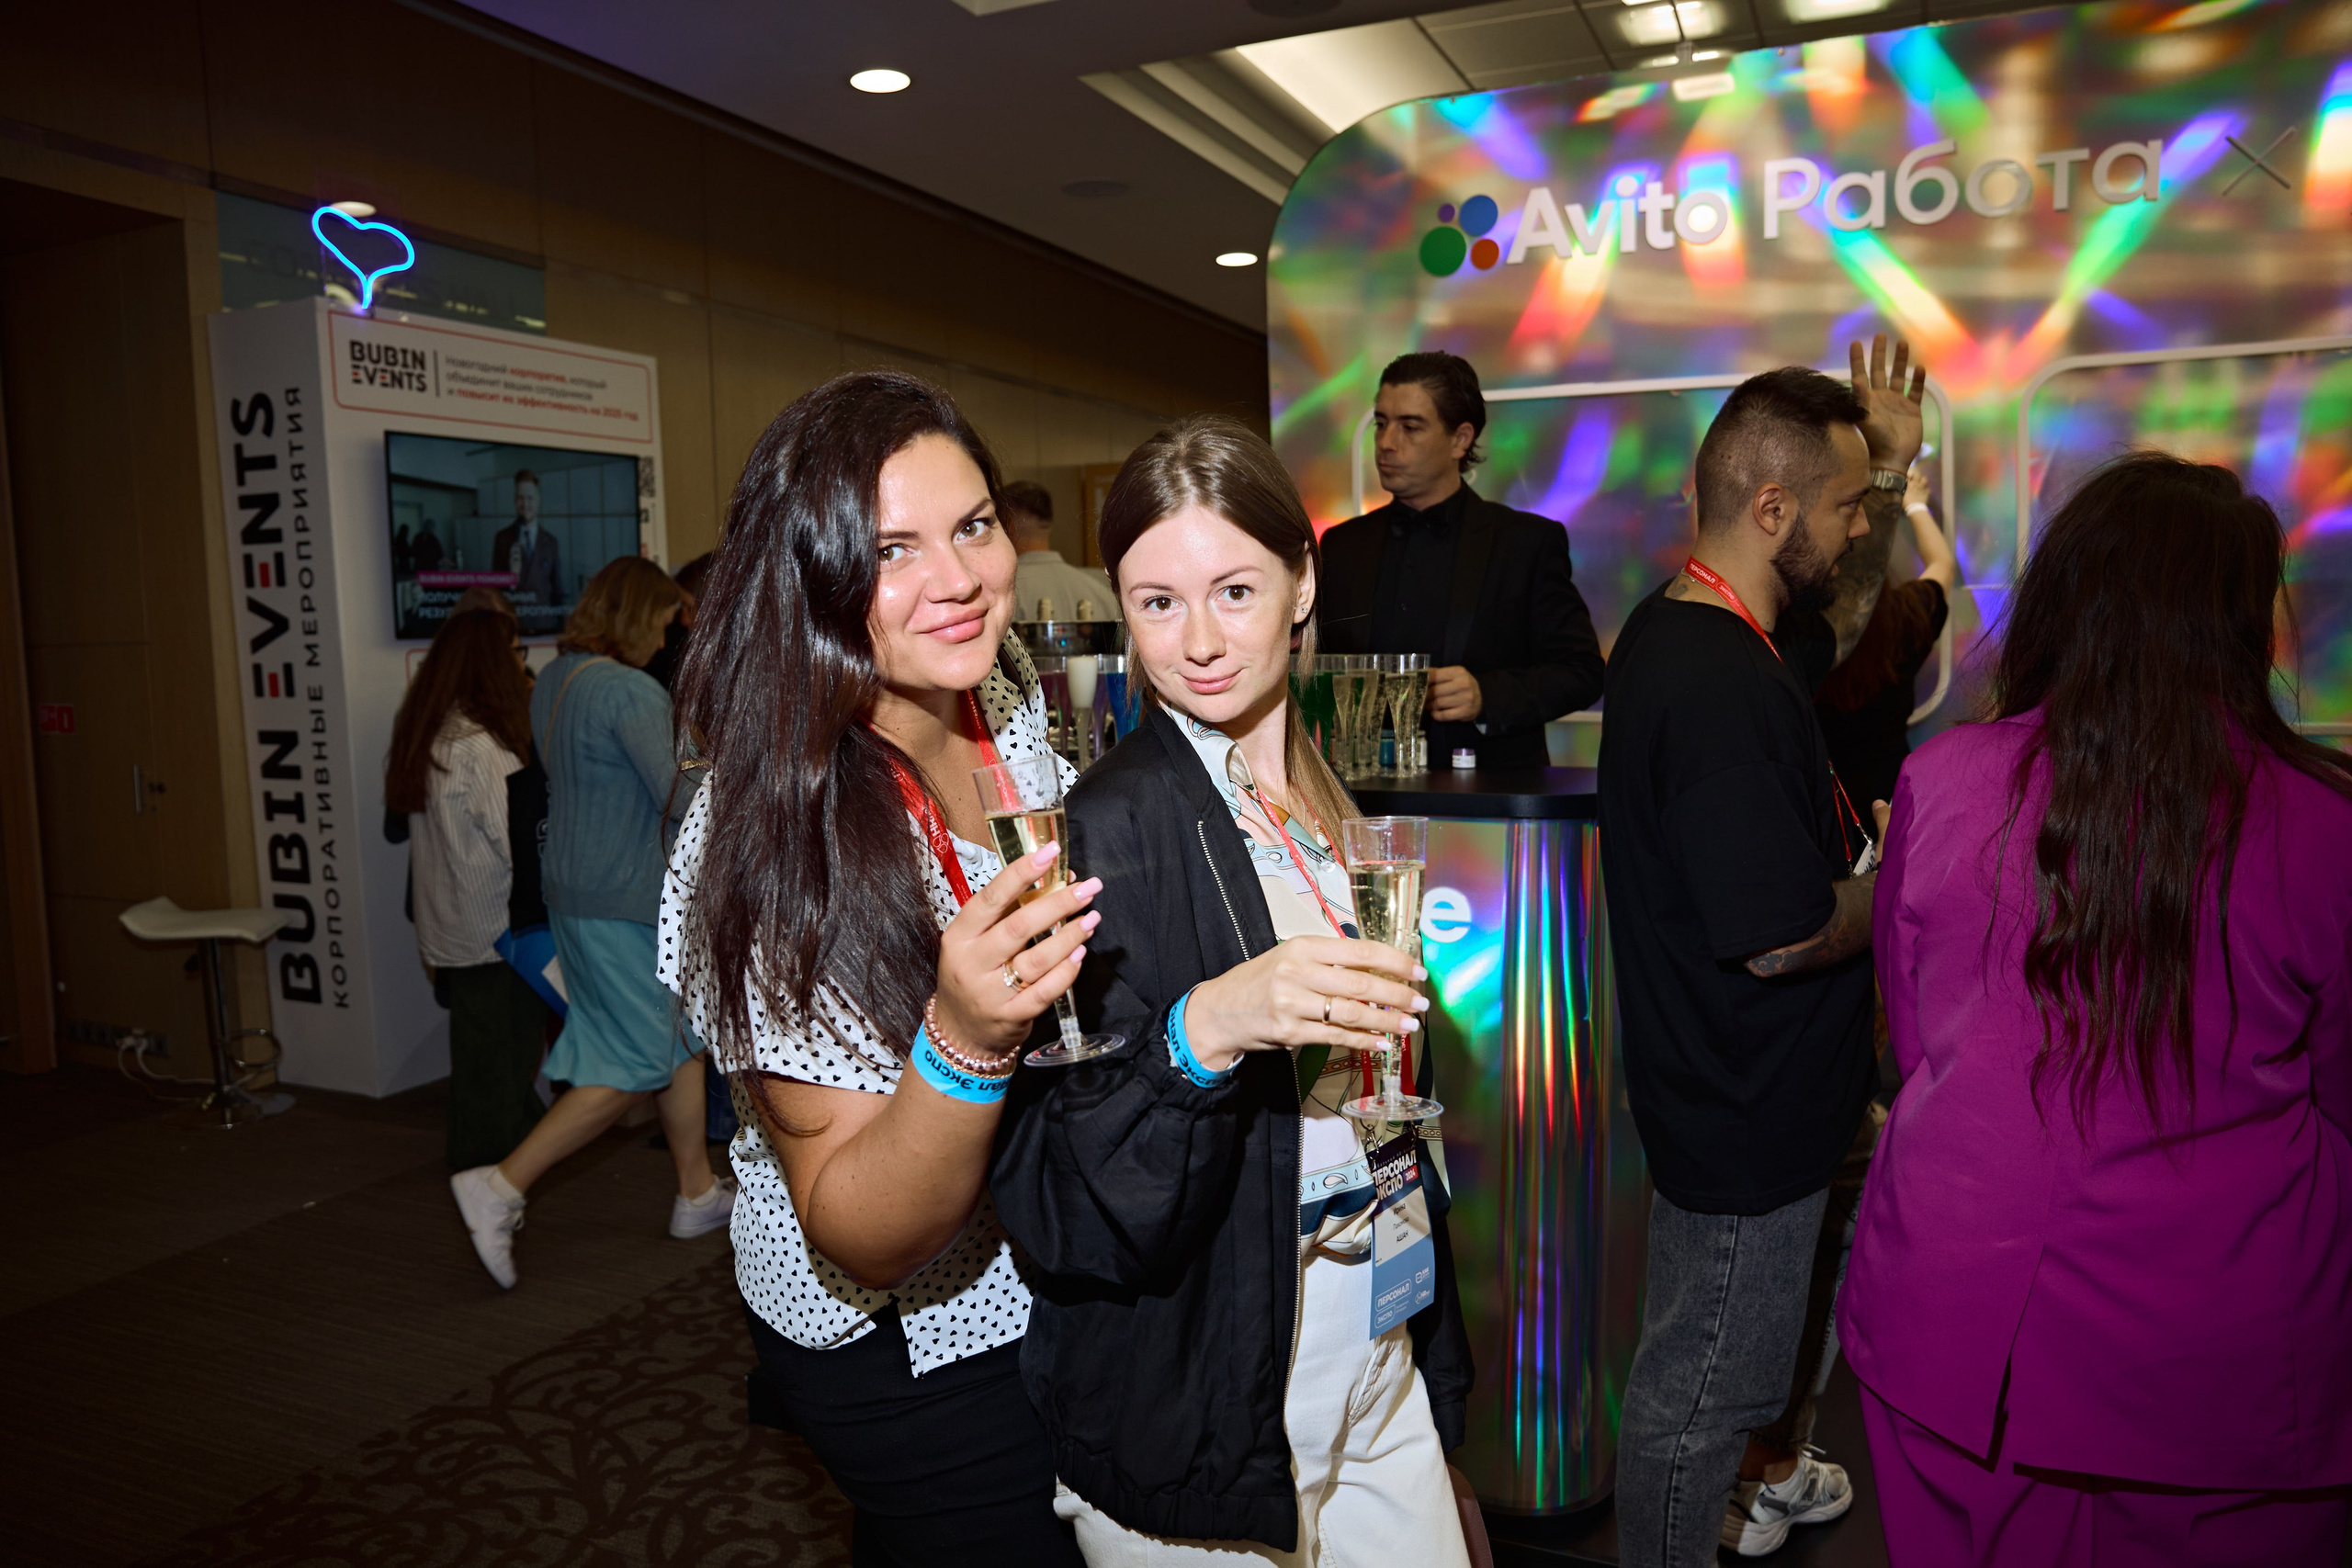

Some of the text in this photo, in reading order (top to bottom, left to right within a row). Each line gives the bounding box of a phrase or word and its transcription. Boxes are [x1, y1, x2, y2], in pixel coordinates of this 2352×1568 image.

[1508, 173, 1728, 265] Avito
[1763, 138, 2163, 240] Работа
[349, 340, 426, 371] BUBIN
[446, 355, 507, 374] Новогодний
[351, 365, 427, 392] EVENTS
[456, 389, 500, 404] повысит
[516, 395, 588, 415] эффективность
[230, 391, 323, 1005] BUBIN EVENTS
[284, 386, 349, 1009] КОРПОРАТИВНЫЕ МЕРОПРИЯТИЯ
[924, 1050, 975, 1089] Экспо
[1372, 1150, 1417, 1186] ПЕРСОНАЛ
[1405, 1168, 1416, 1181] 2024
[1377, 1282, 1409, 1307] ПЕРСОНАЛ
[1377, 1311, 1393, 1324] ЭКСПО
